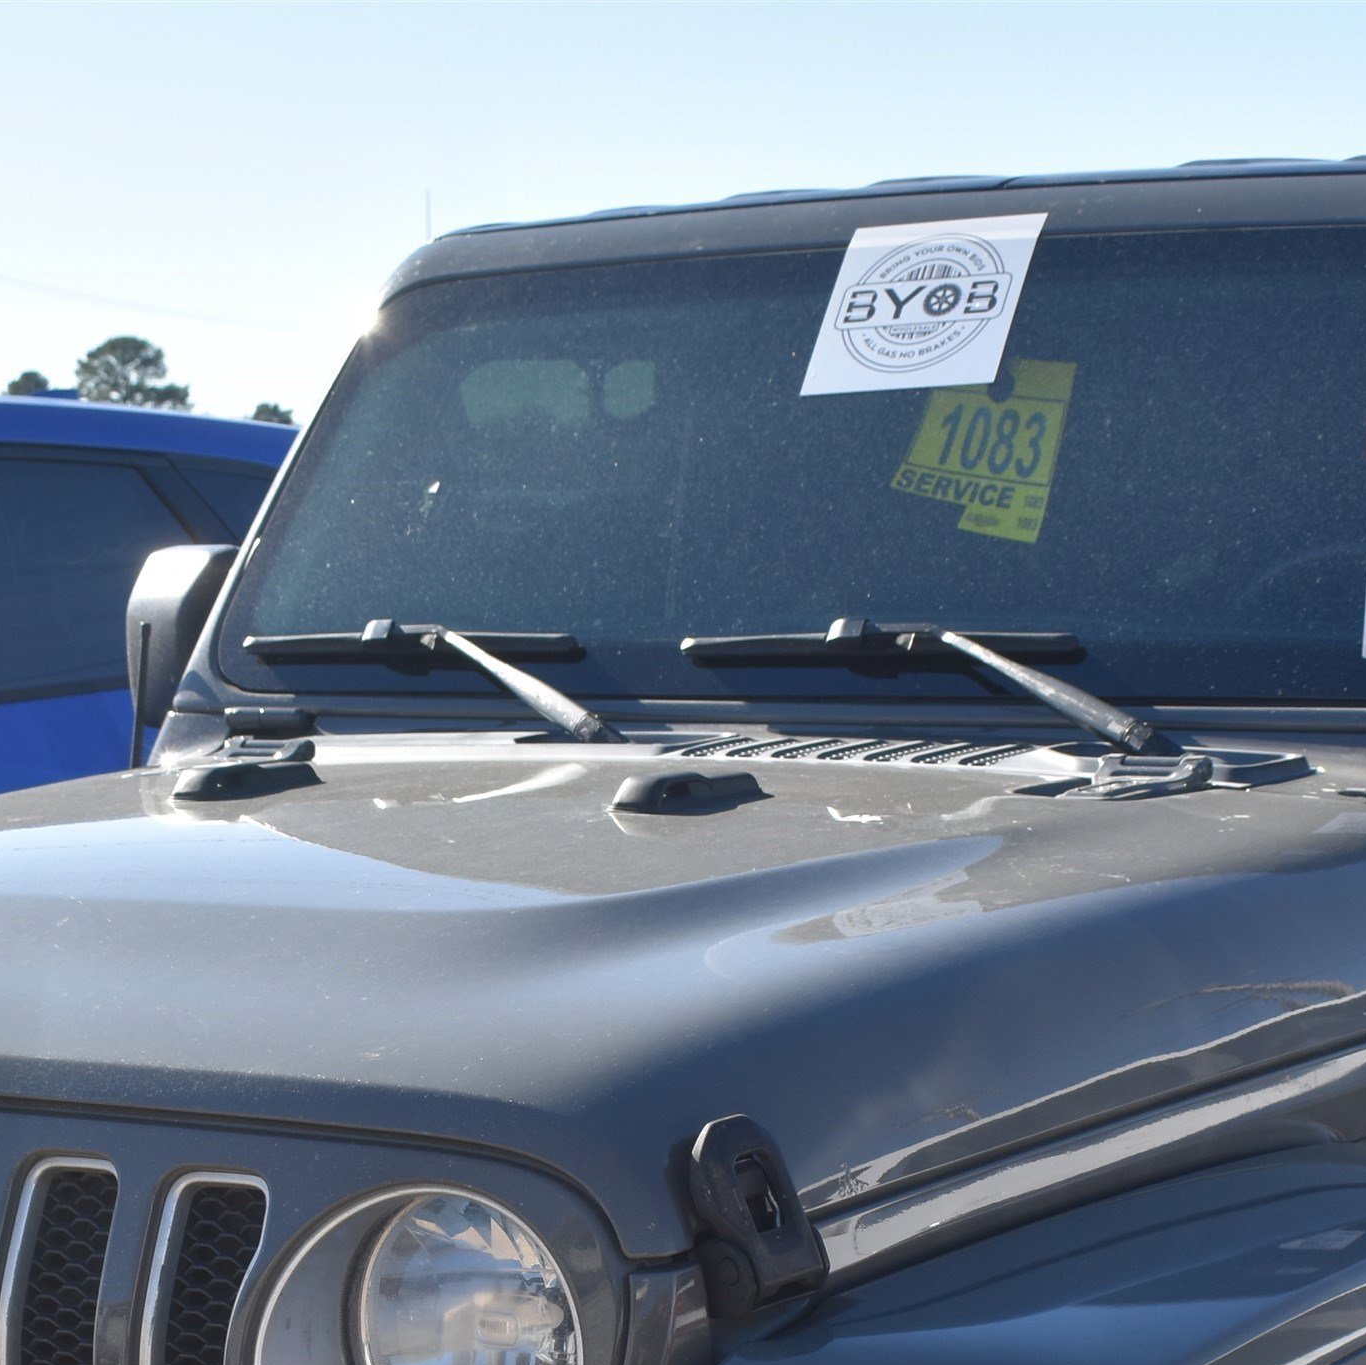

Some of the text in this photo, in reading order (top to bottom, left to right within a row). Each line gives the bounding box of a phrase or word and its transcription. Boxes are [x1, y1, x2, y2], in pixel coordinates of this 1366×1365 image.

[880, 254, 911, 279] BRING
[914, 245, 945, 257] YOUR
[946, 244, 968, 256] OWN
[843, 280, 999, 324] BYOB
[864, 330, 962, 359] ALL GAS NO BRAKES
[938, 402, 1046, 479] 1083
[896, 469, 1016, 510] SERVICE
